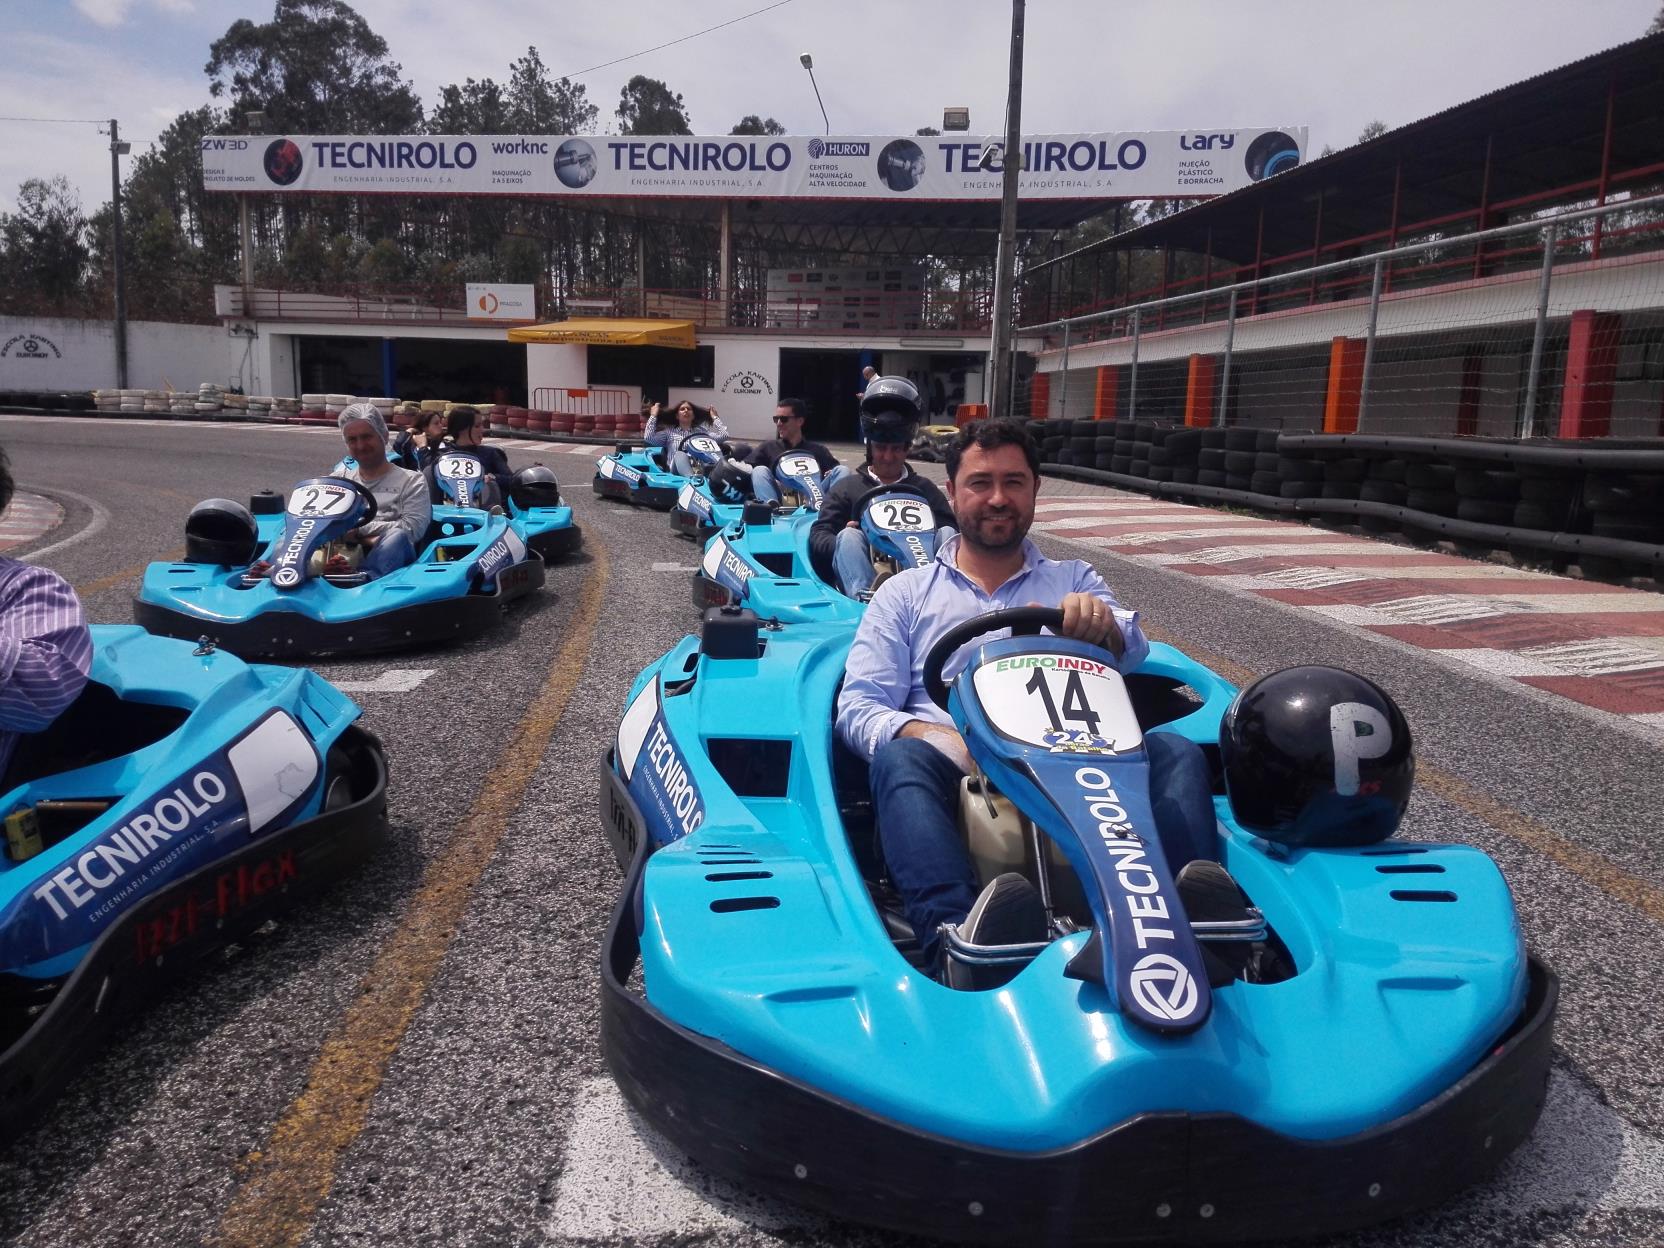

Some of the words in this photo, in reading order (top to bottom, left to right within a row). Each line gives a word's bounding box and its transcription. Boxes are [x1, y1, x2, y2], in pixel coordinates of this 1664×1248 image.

[492, 138, 548, 154] worknc
[829, 144, 867, 155] HURON
[312, 142, 477, 169] TECNIROLO
[608, 143, 792, 171] TECNIROLO
[1178, 168, 1213, 176] PLÁSTICO
[1179, 160, 1210, 168] INJEÇÃO
[333, 175, 383, 183] ENGENHARIA
[631, 179, 686, 187] ENGENHARIA
[964, 181, 1025, 189] ENGENHA
[1184, 177, 1224, 185] BORRACHA
[699, 440, 716, 450] 31
[451, 460, 475, 475] 28
[794, 461, 809, 472] 5
[302, 488, 346, 511] 27
[883, 504, 922, 527] 26
[996, 657, 1107, 675] EUROINDY
[1026, 667, 1101, 735] 14
[1330, 702, 1393, 797] P
[33, 771, 227, 921] TECNIROLO
[1075, 767, 1175, 949] TECNIROLO
[89, 873, 149, 923] ENGENHARIA
